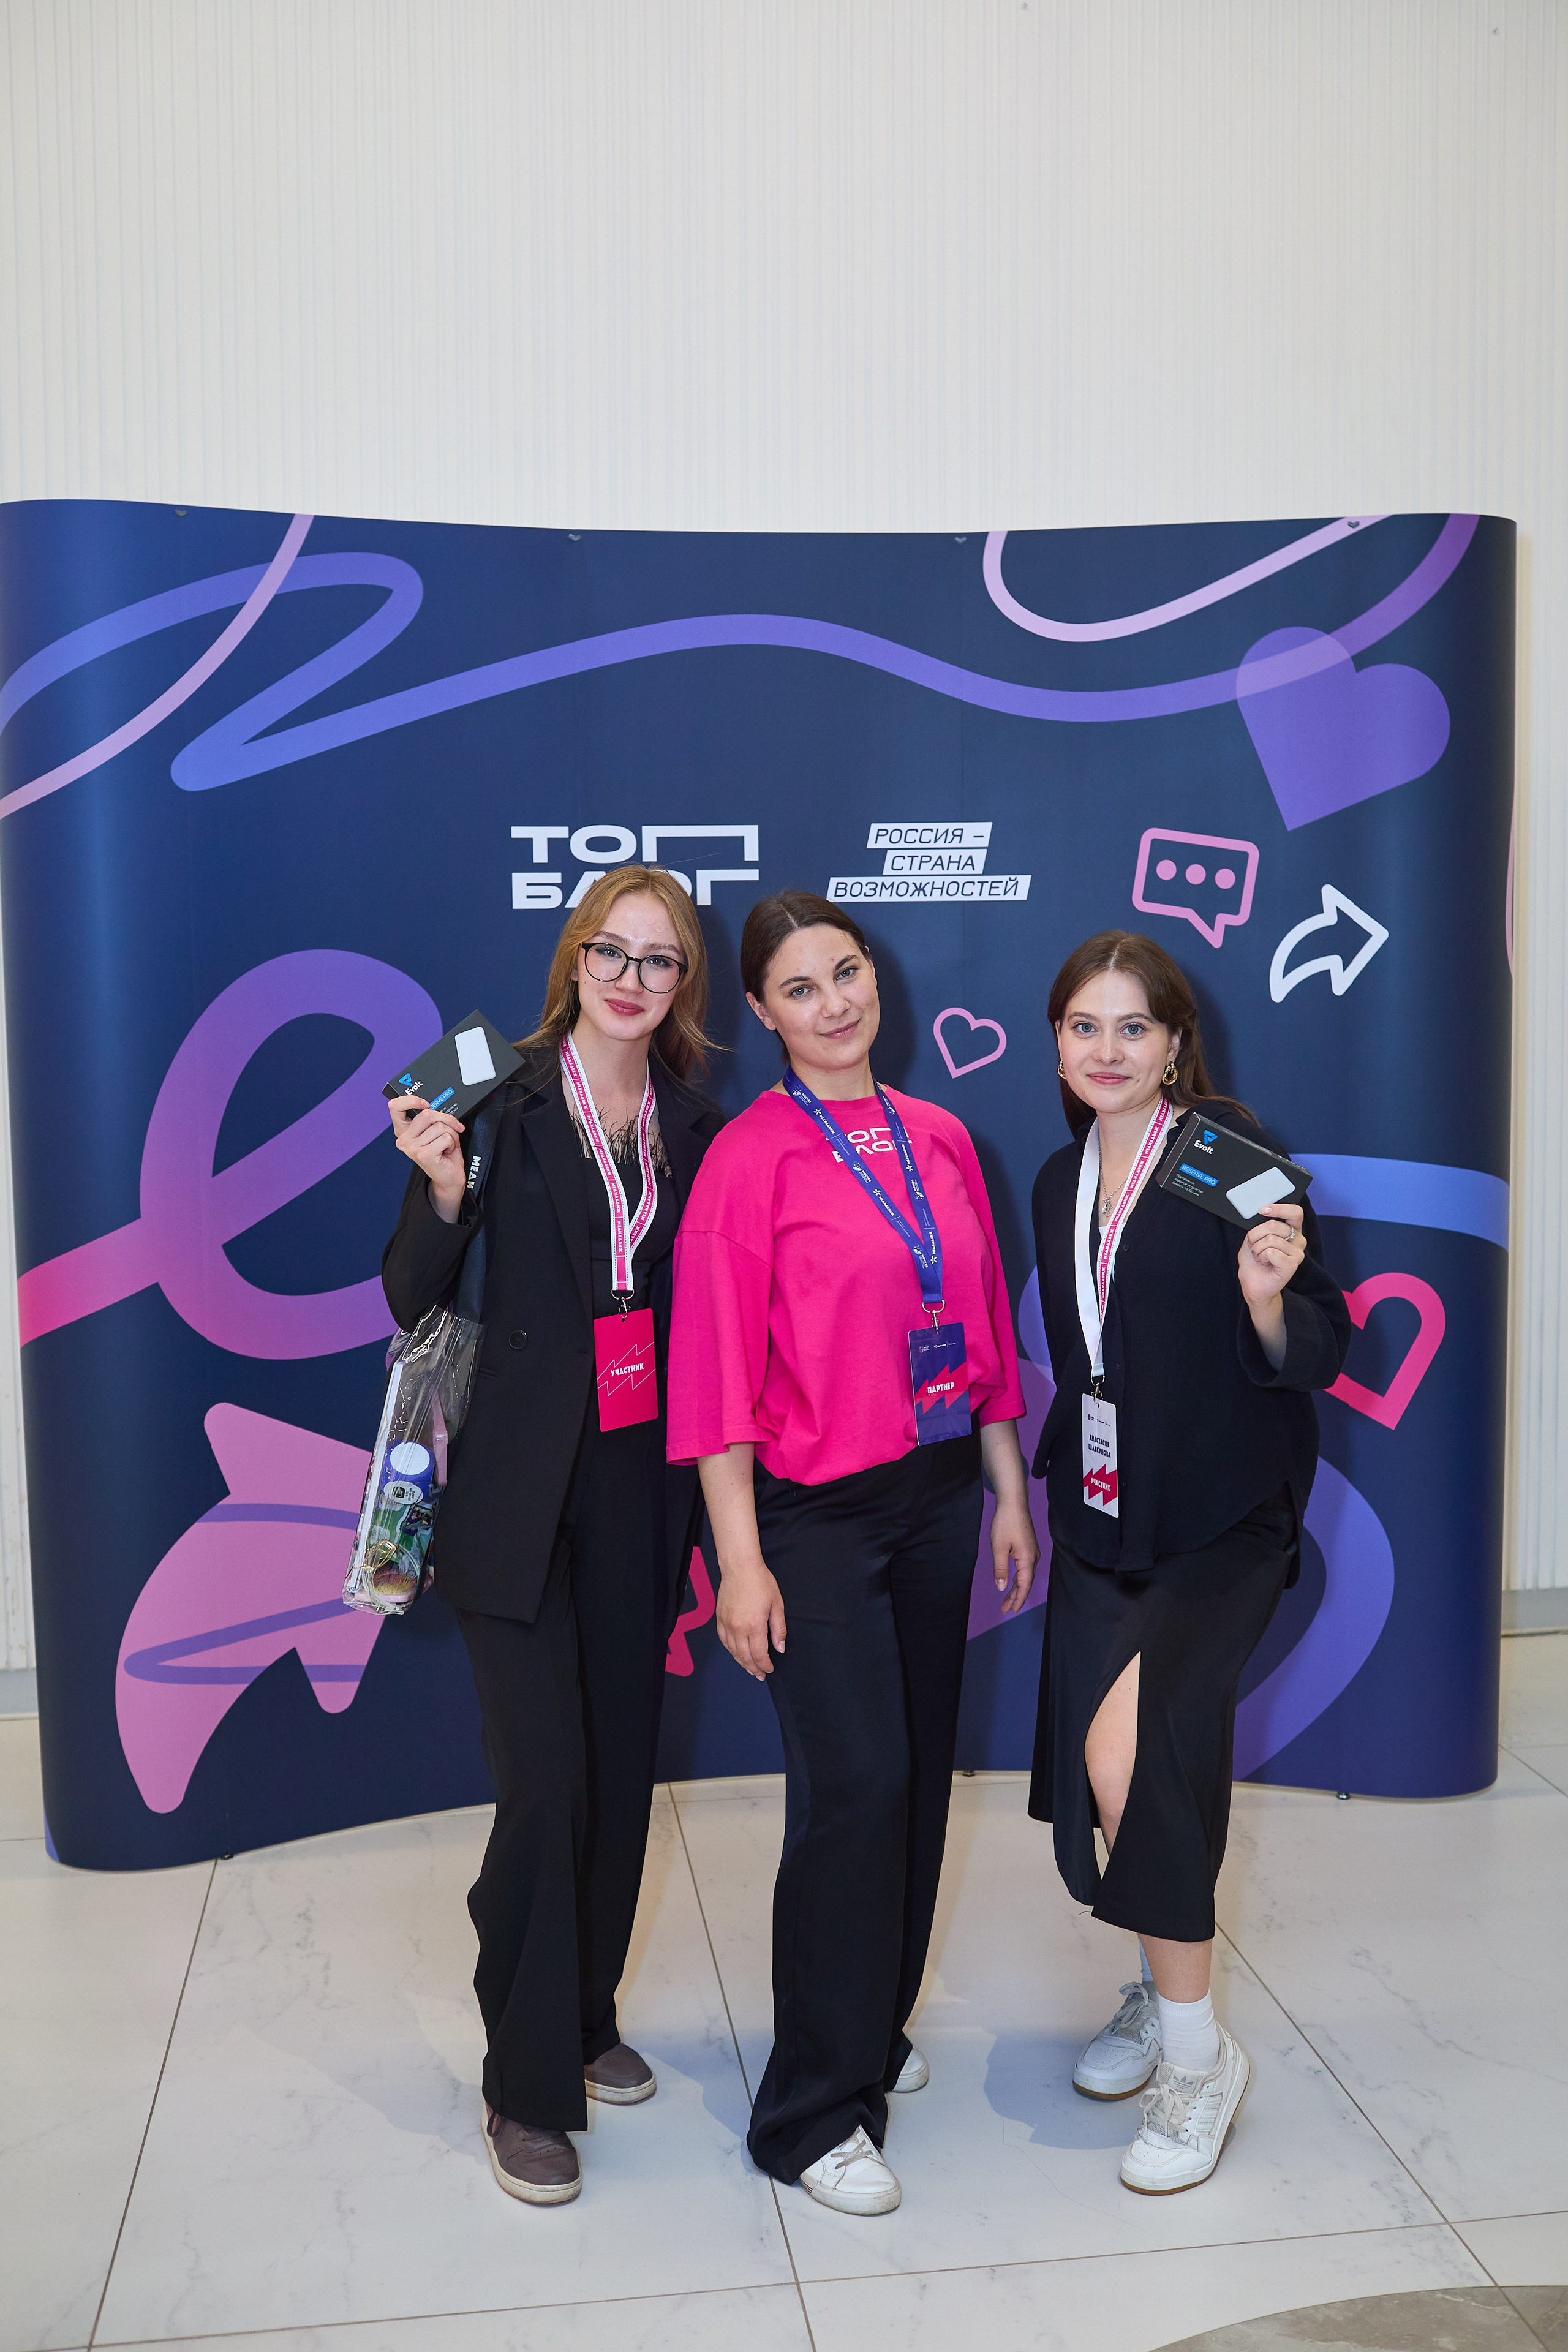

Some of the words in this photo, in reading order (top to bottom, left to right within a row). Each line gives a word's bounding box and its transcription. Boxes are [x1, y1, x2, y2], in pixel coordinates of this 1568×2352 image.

[511, 824, 759, 864] ТОП
[875, 828, 964, 845] РОССИЯ
[891, 855, 976, 871] СТРАНА
[834, 877, 1019, 897] ВОЗМОЖНОСТЕЙ
[405, 1080, 423, 1096] Evolt
[429, 1096, 444, 1110] SERVE
[442, 1089, 453, 1099] PRO
[1194, 1139, 1214, 1155] Evolt
[1182, 1165, 1204, 1180] RESERVE
[1204, 1176, 1216, 1185] PRO
[610, 1362, 644, 1378] УЧАСТНИК
[927, 1382, 955, 1394] ПАРТНЕР
[1089, 1434, 1110, 1448] АНАСТАСИЯ
[1088, 1443, 1111, 1458] ШАВКУНОВА
[1090, 1477, 1111, 1492] УЧАСТНИК
